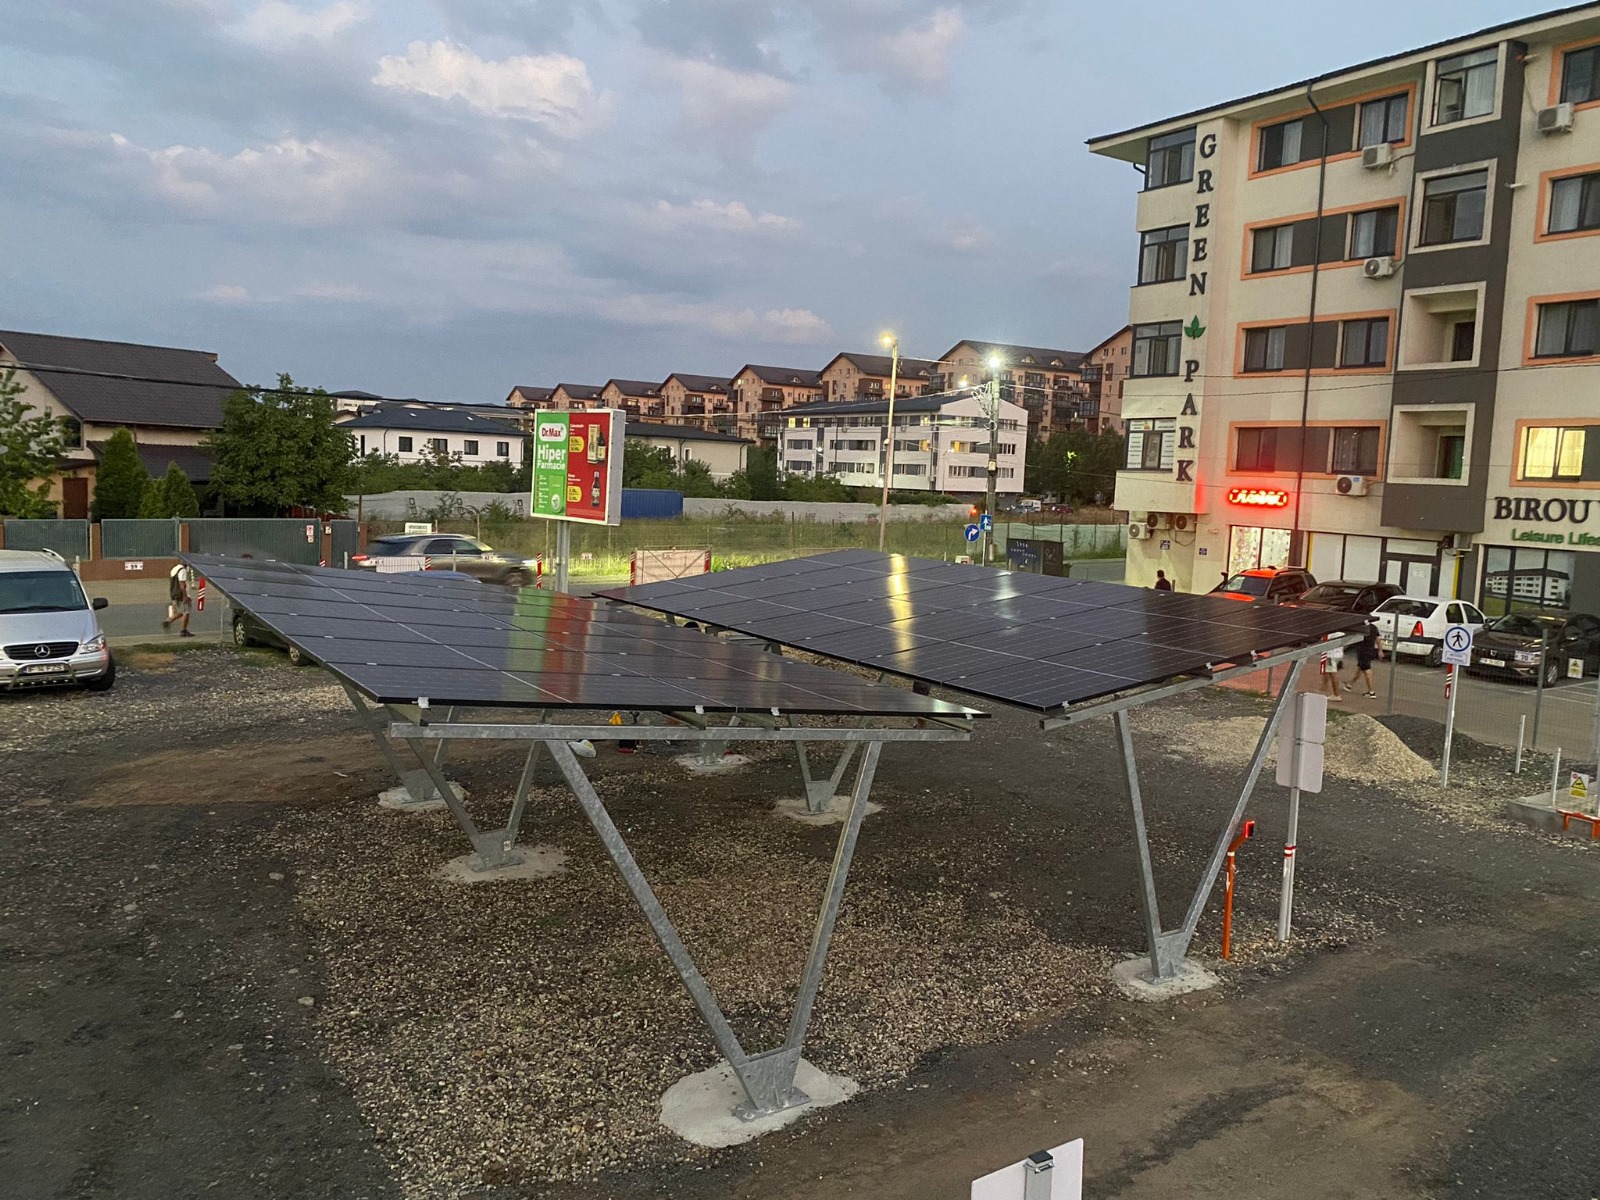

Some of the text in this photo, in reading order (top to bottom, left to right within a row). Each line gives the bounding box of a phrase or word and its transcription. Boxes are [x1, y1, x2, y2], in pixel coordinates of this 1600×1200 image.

[1176, 133, 1217, 483] GREEN PARK
[541, 428, 561, 437] Dr.Max
[537, 444, 566, 462] Hiper
[537, 459, 566, 470] Farmacie
[1493, 496, 1590, 524] BIROU
[1511, 528, 1565, 544] Leisure
